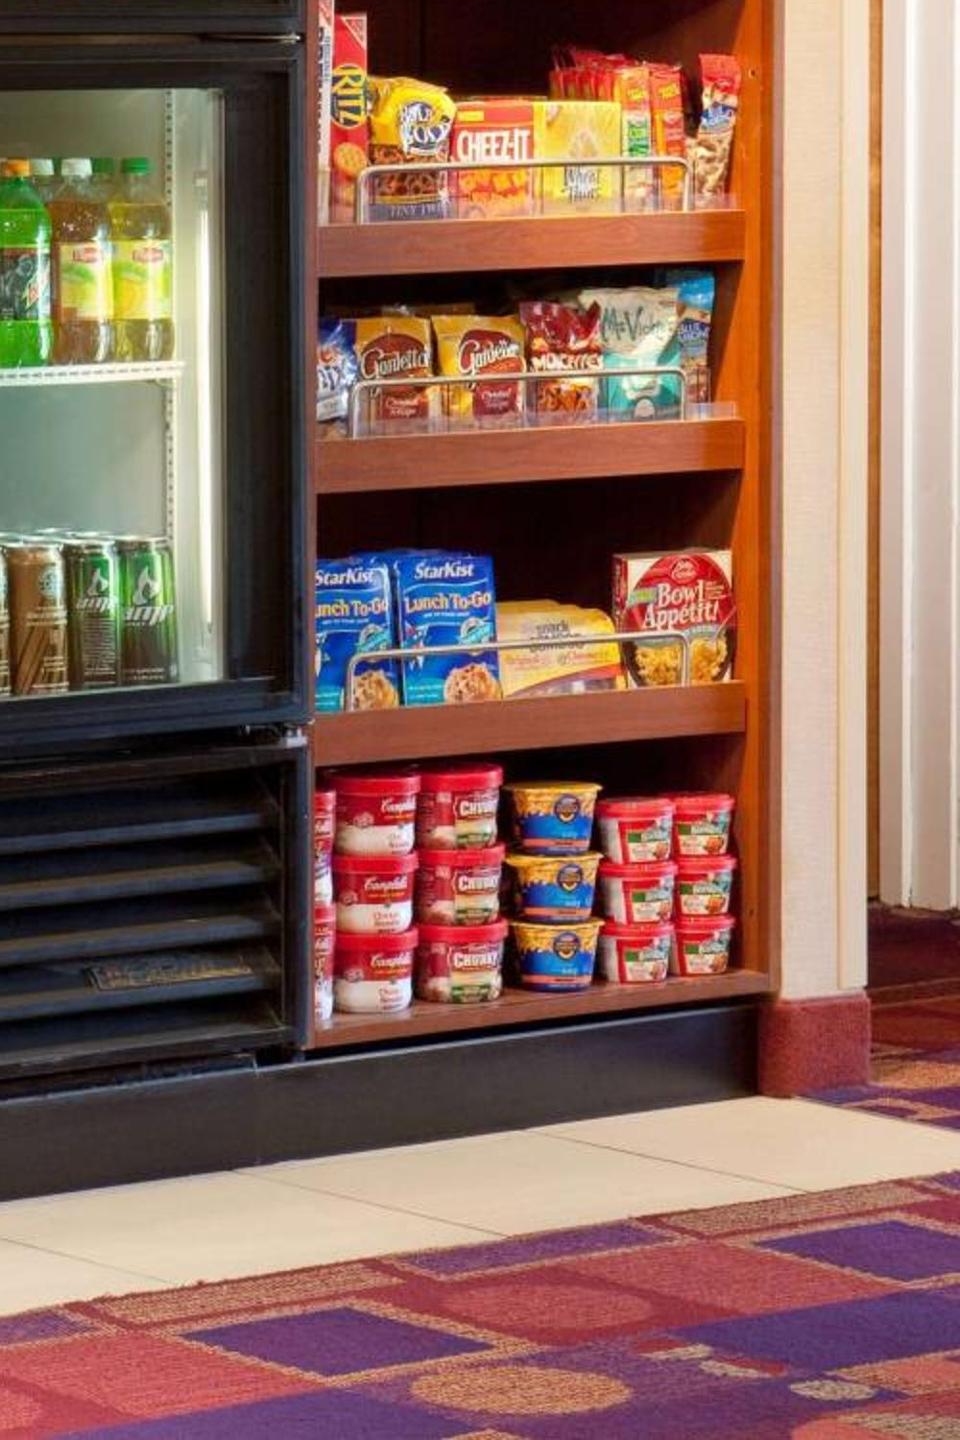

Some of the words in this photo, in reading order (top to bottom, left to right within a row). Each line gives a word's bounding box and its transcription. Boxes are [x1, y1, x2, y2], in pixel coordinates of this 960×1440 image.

[332, 69, 367, 126] RITZ
[456, 127, 530, 161] CHEEZ-IT
[315, 568, 374, 586] StarKist
[415, 560, 474, 579] StarKist
[404, 594, 448, 614] Lunch
[448, 591, 491, 610] To-Go
[658, 578, 704, 608] Bowl
[316, 598, 349, 618] unch
[351, 597, 387, 617] To-Go
